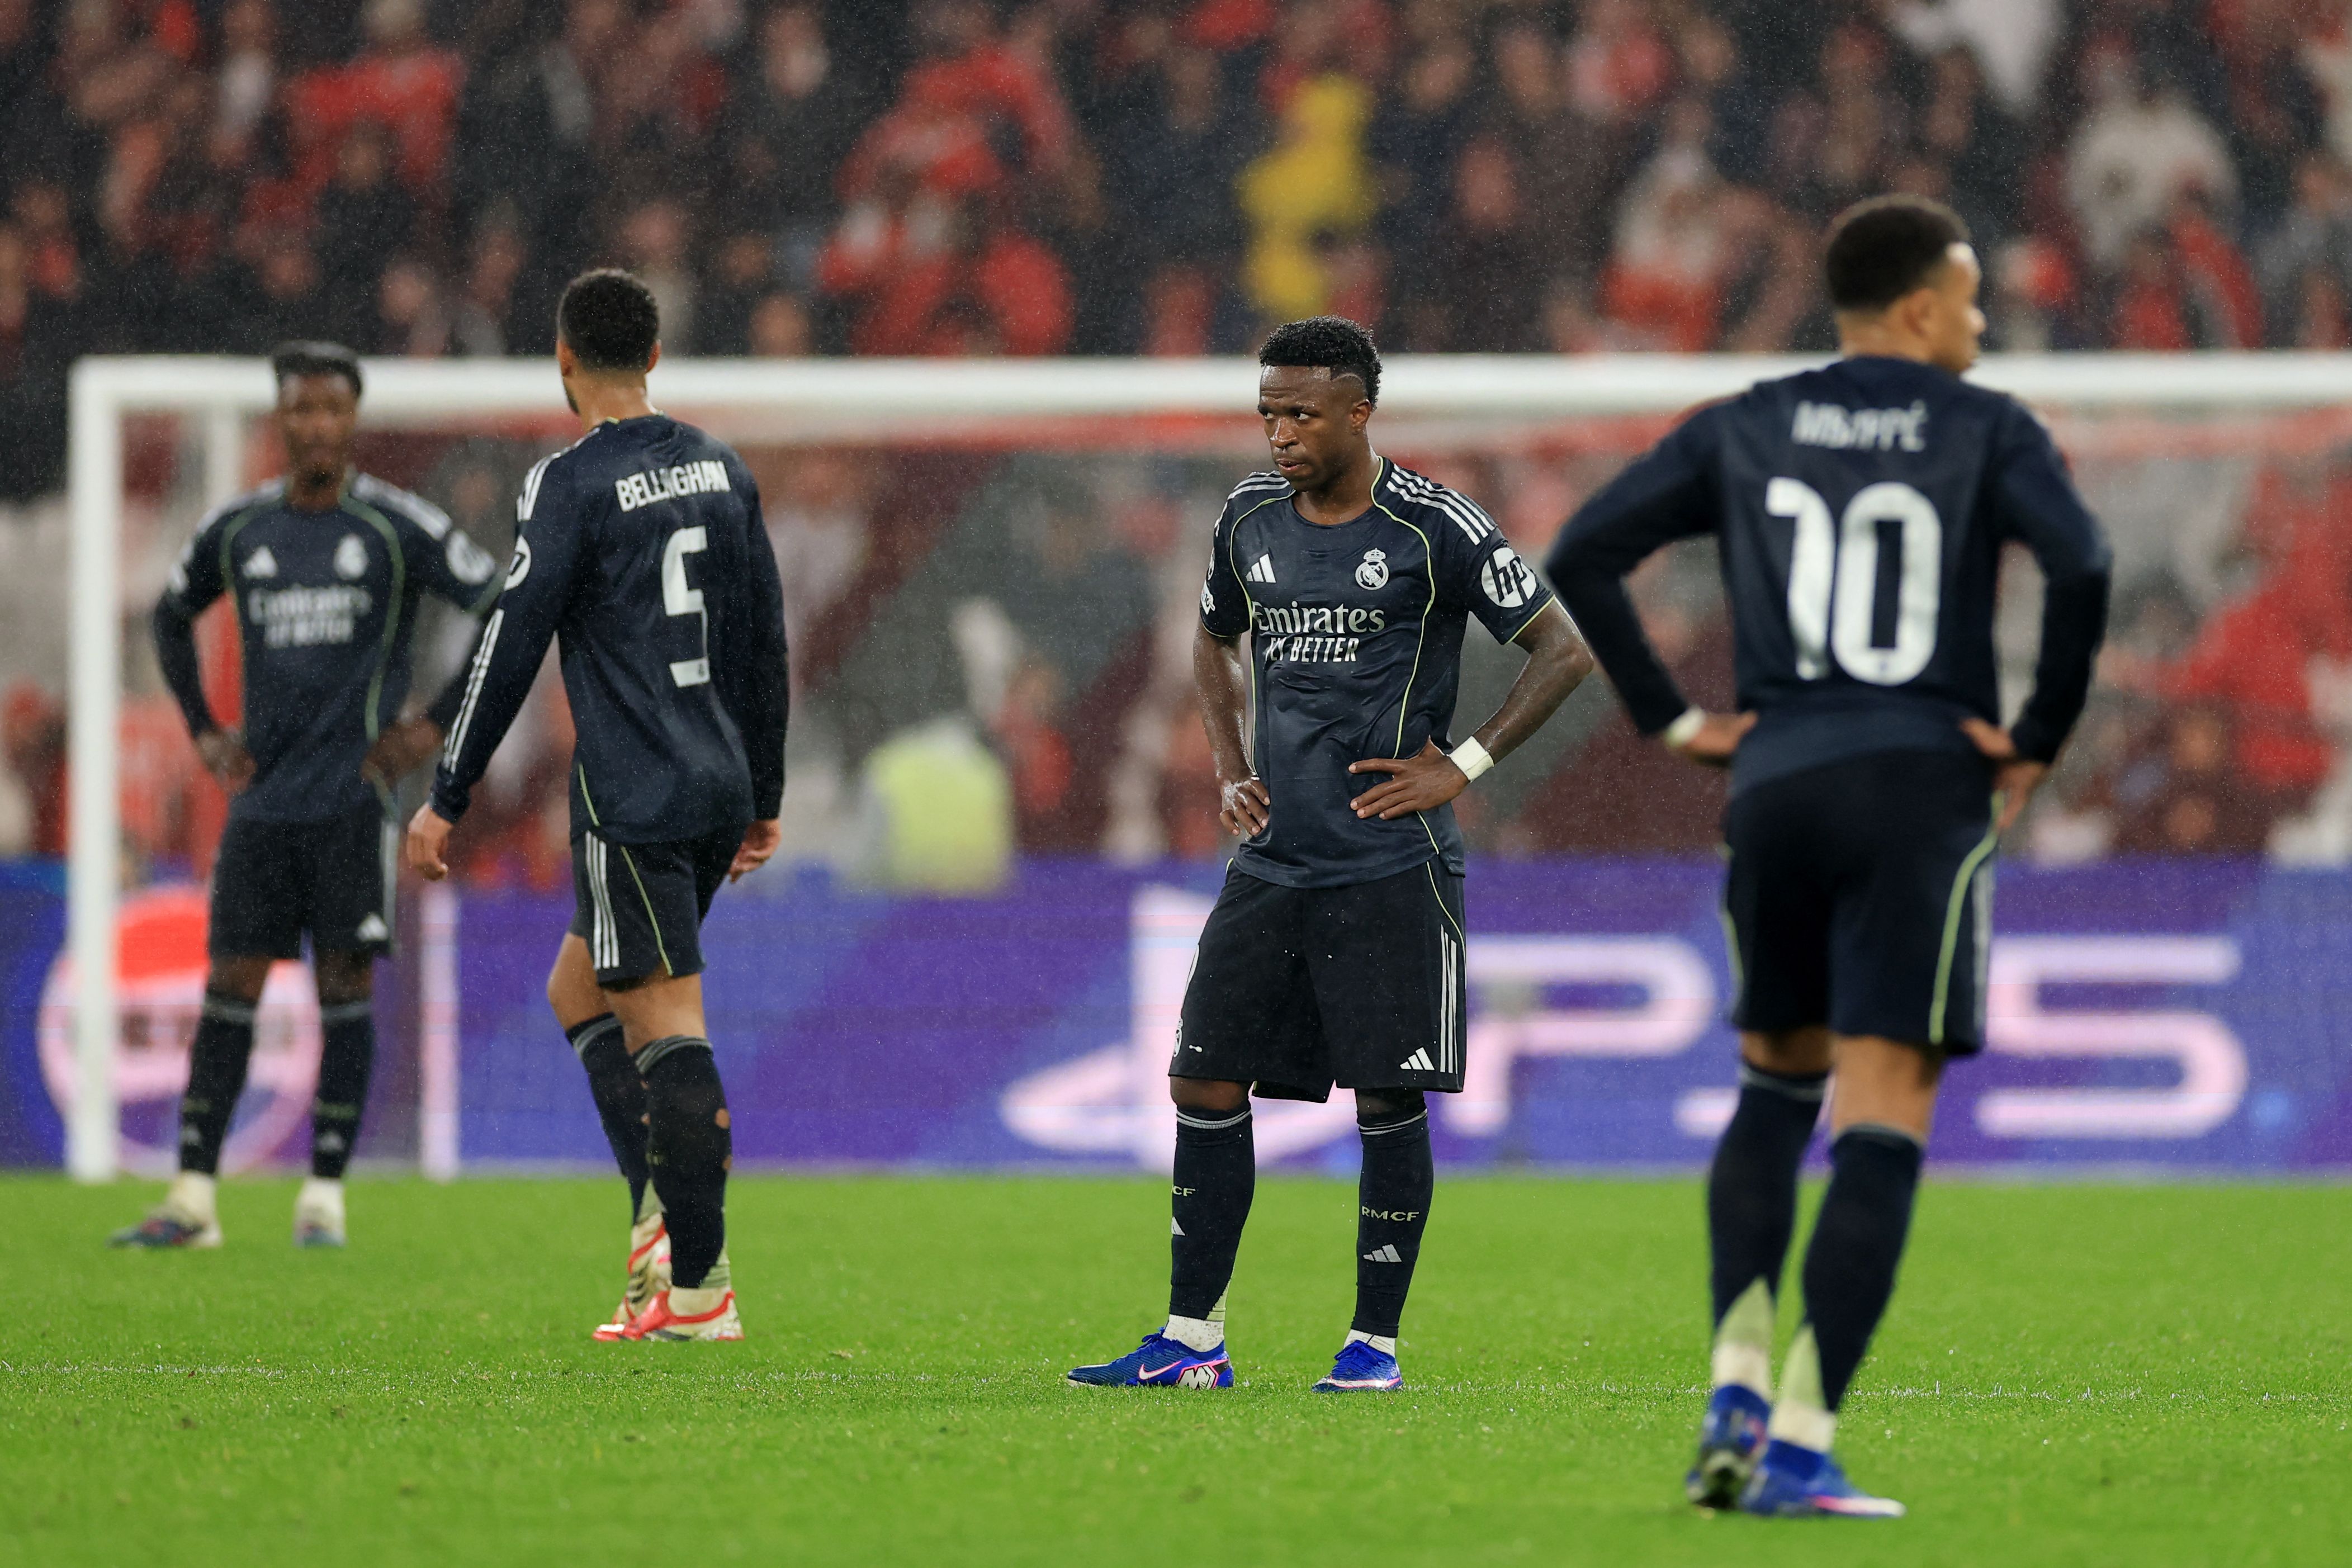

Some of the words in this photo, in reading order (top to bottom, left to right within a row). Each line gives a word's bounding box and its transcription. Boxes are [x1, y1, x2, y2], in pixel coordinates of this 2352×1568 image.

[1487, 550, 1530, 605] hp
[1765, 476, 1942, 686] 10
[662, 525, 710, 688] 5
[1252, 601, 1385, 633] Emirates
[1290, 637, 1360, 662] BETTER
[1171, 1185, 1196, 1197] CF
[1362, 1205, 1419, 1221] RMCF
